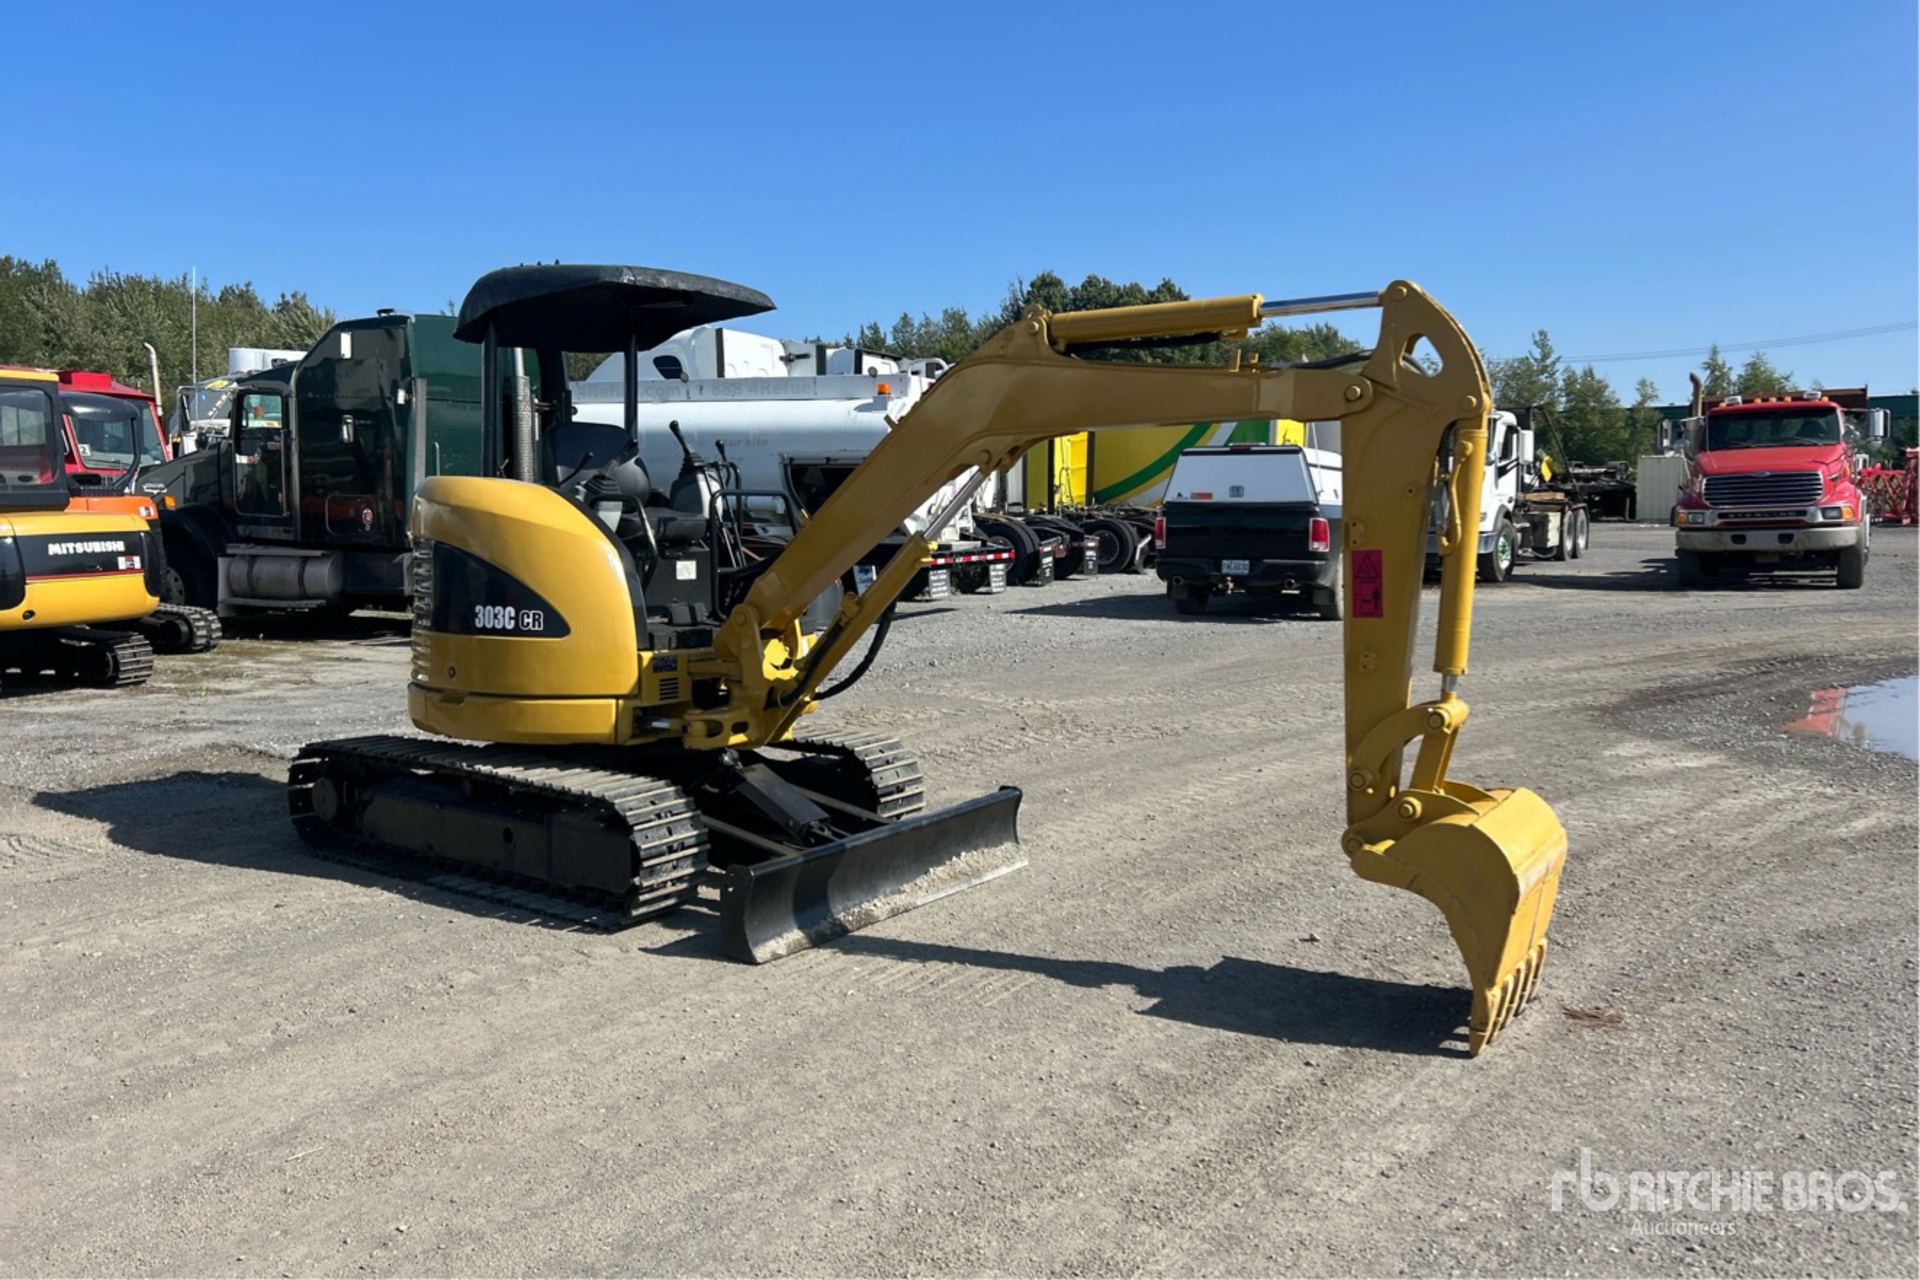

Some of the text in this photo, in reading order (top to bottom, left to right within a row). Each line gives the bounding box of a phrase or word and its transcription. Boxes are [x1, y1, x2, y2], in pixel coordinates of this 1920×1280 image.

[711, 381, 742, 396] 888
[47, 541, 125, 556] MITSUBISHI
[475, 605, 543, 630] 303C CR
